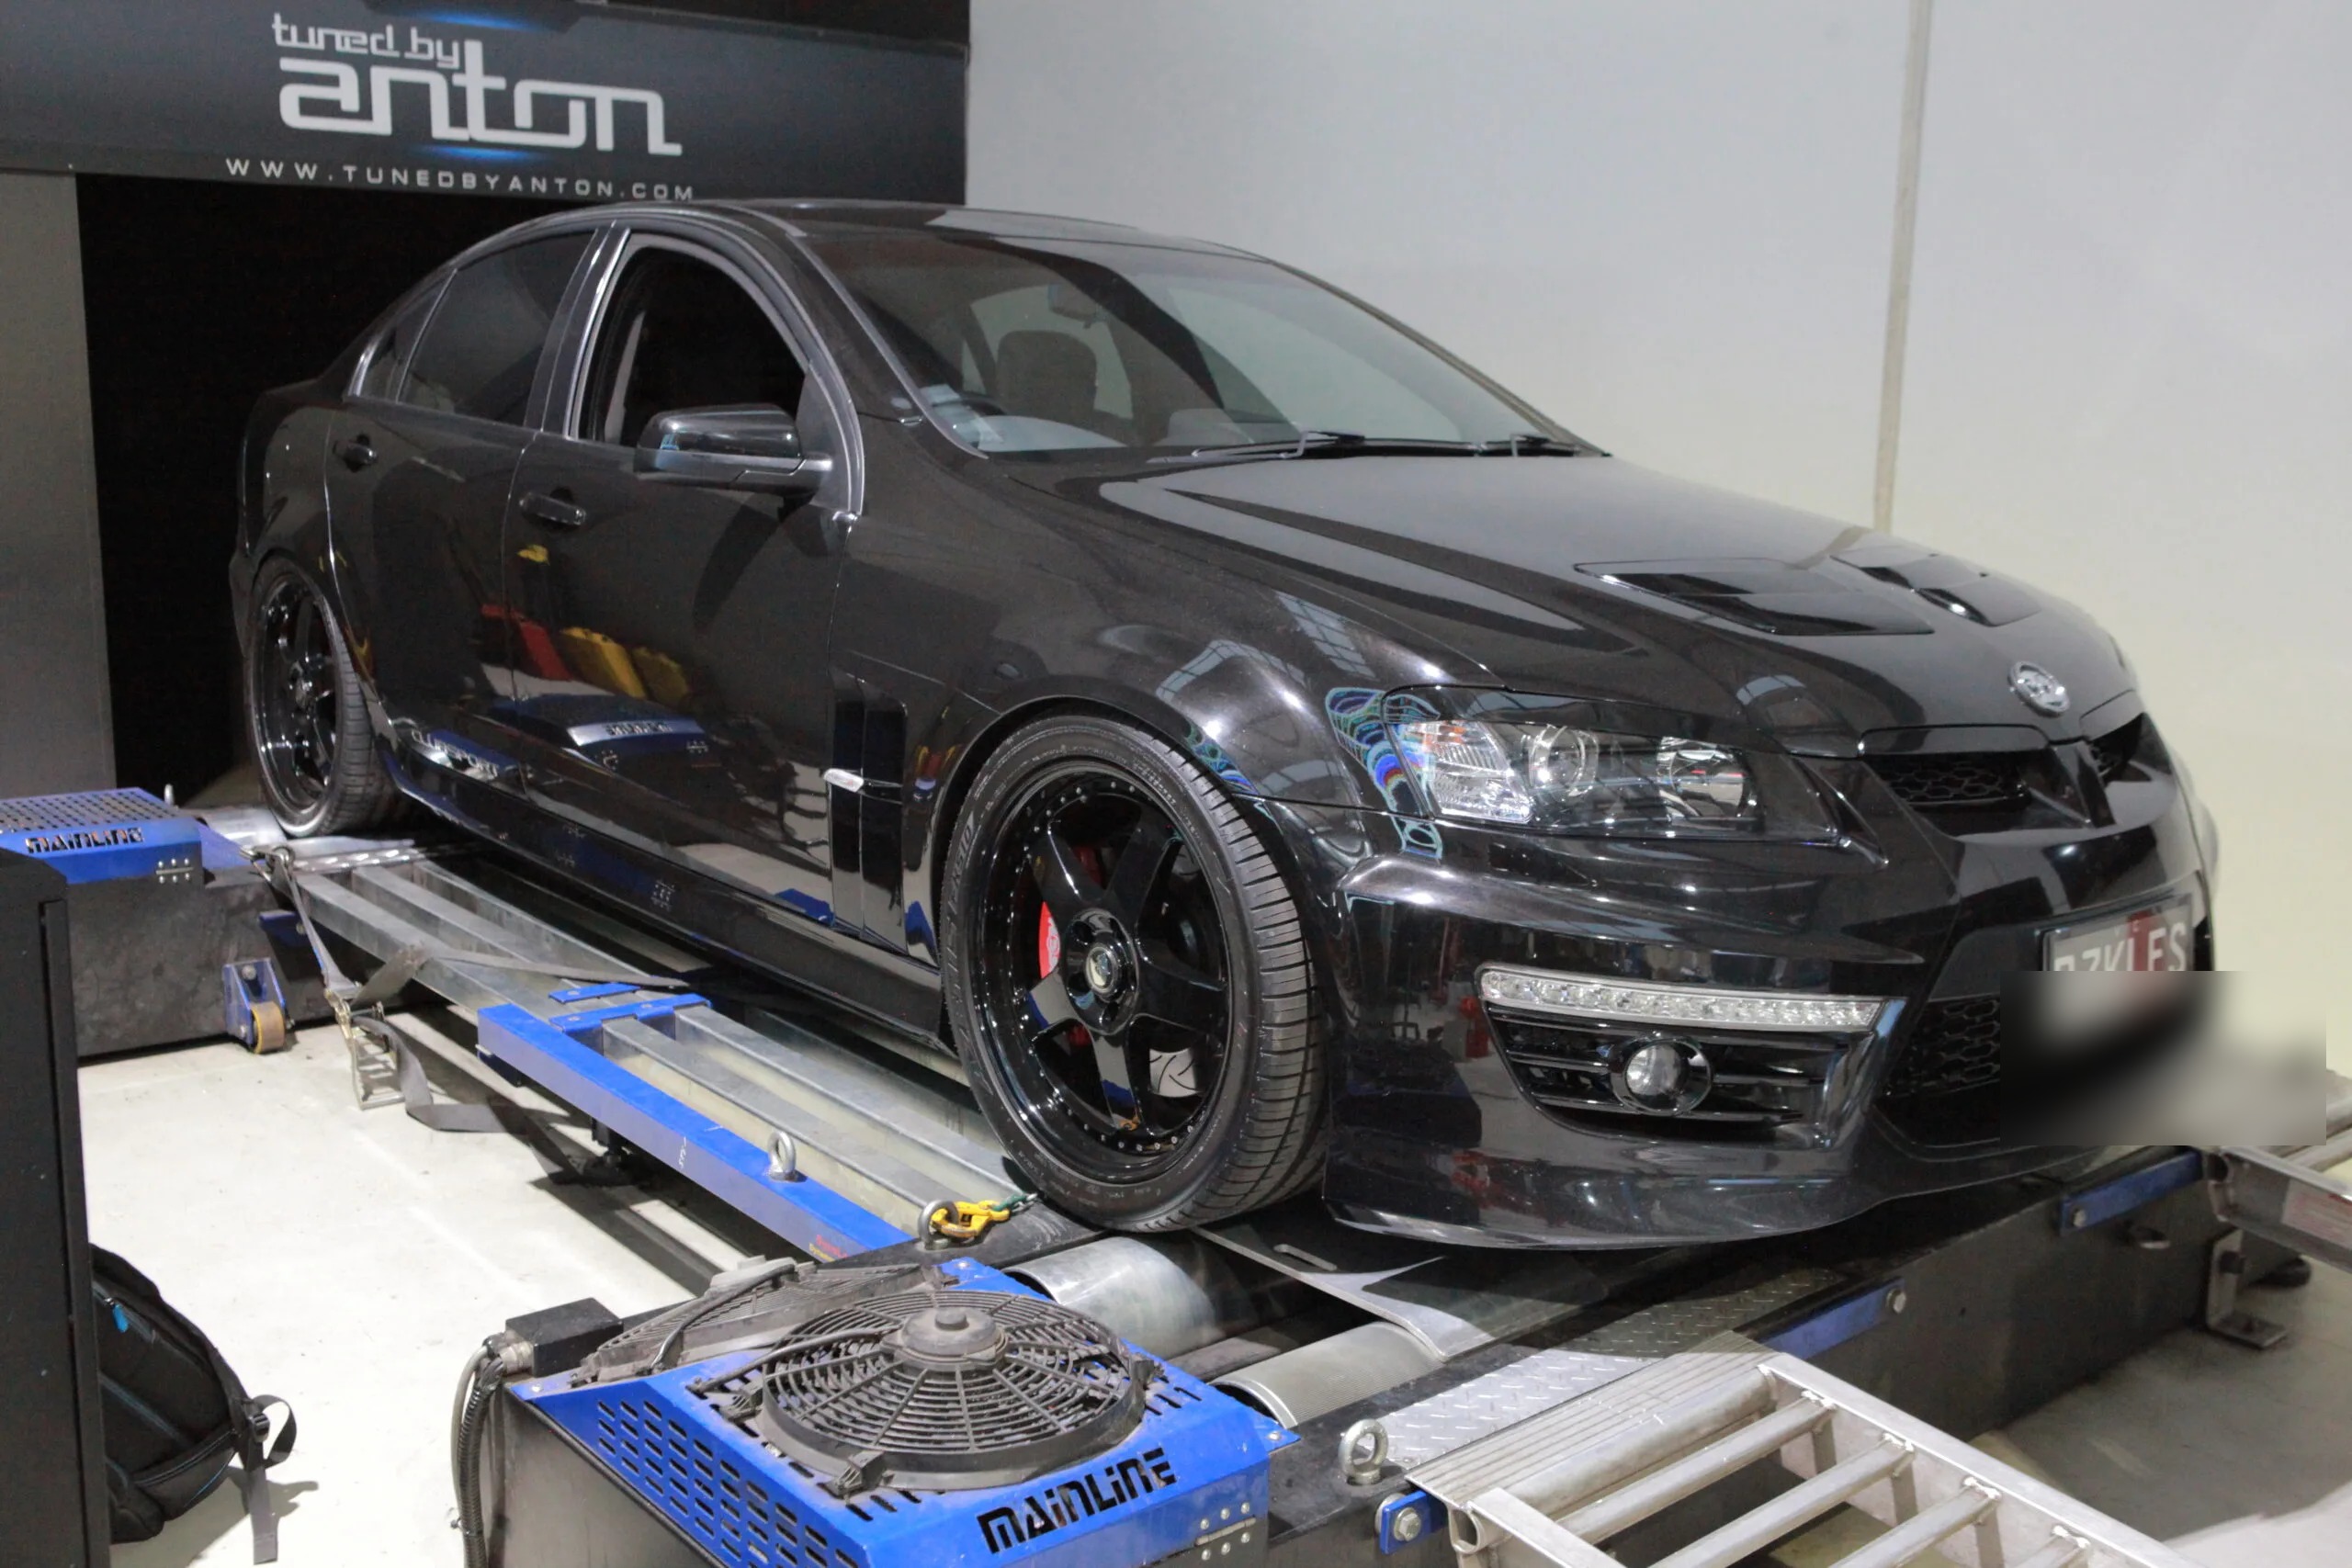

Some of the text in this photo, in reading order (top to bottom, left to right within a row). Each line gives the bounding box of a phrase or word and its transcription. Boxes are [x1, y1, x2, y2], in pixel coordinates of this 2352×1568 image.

[272, 12, 459, 69] tuned by
[279, 39, 683, 155] anton
[226, 157, 693, 201] WWW.TUNEDBYANTON.COM
